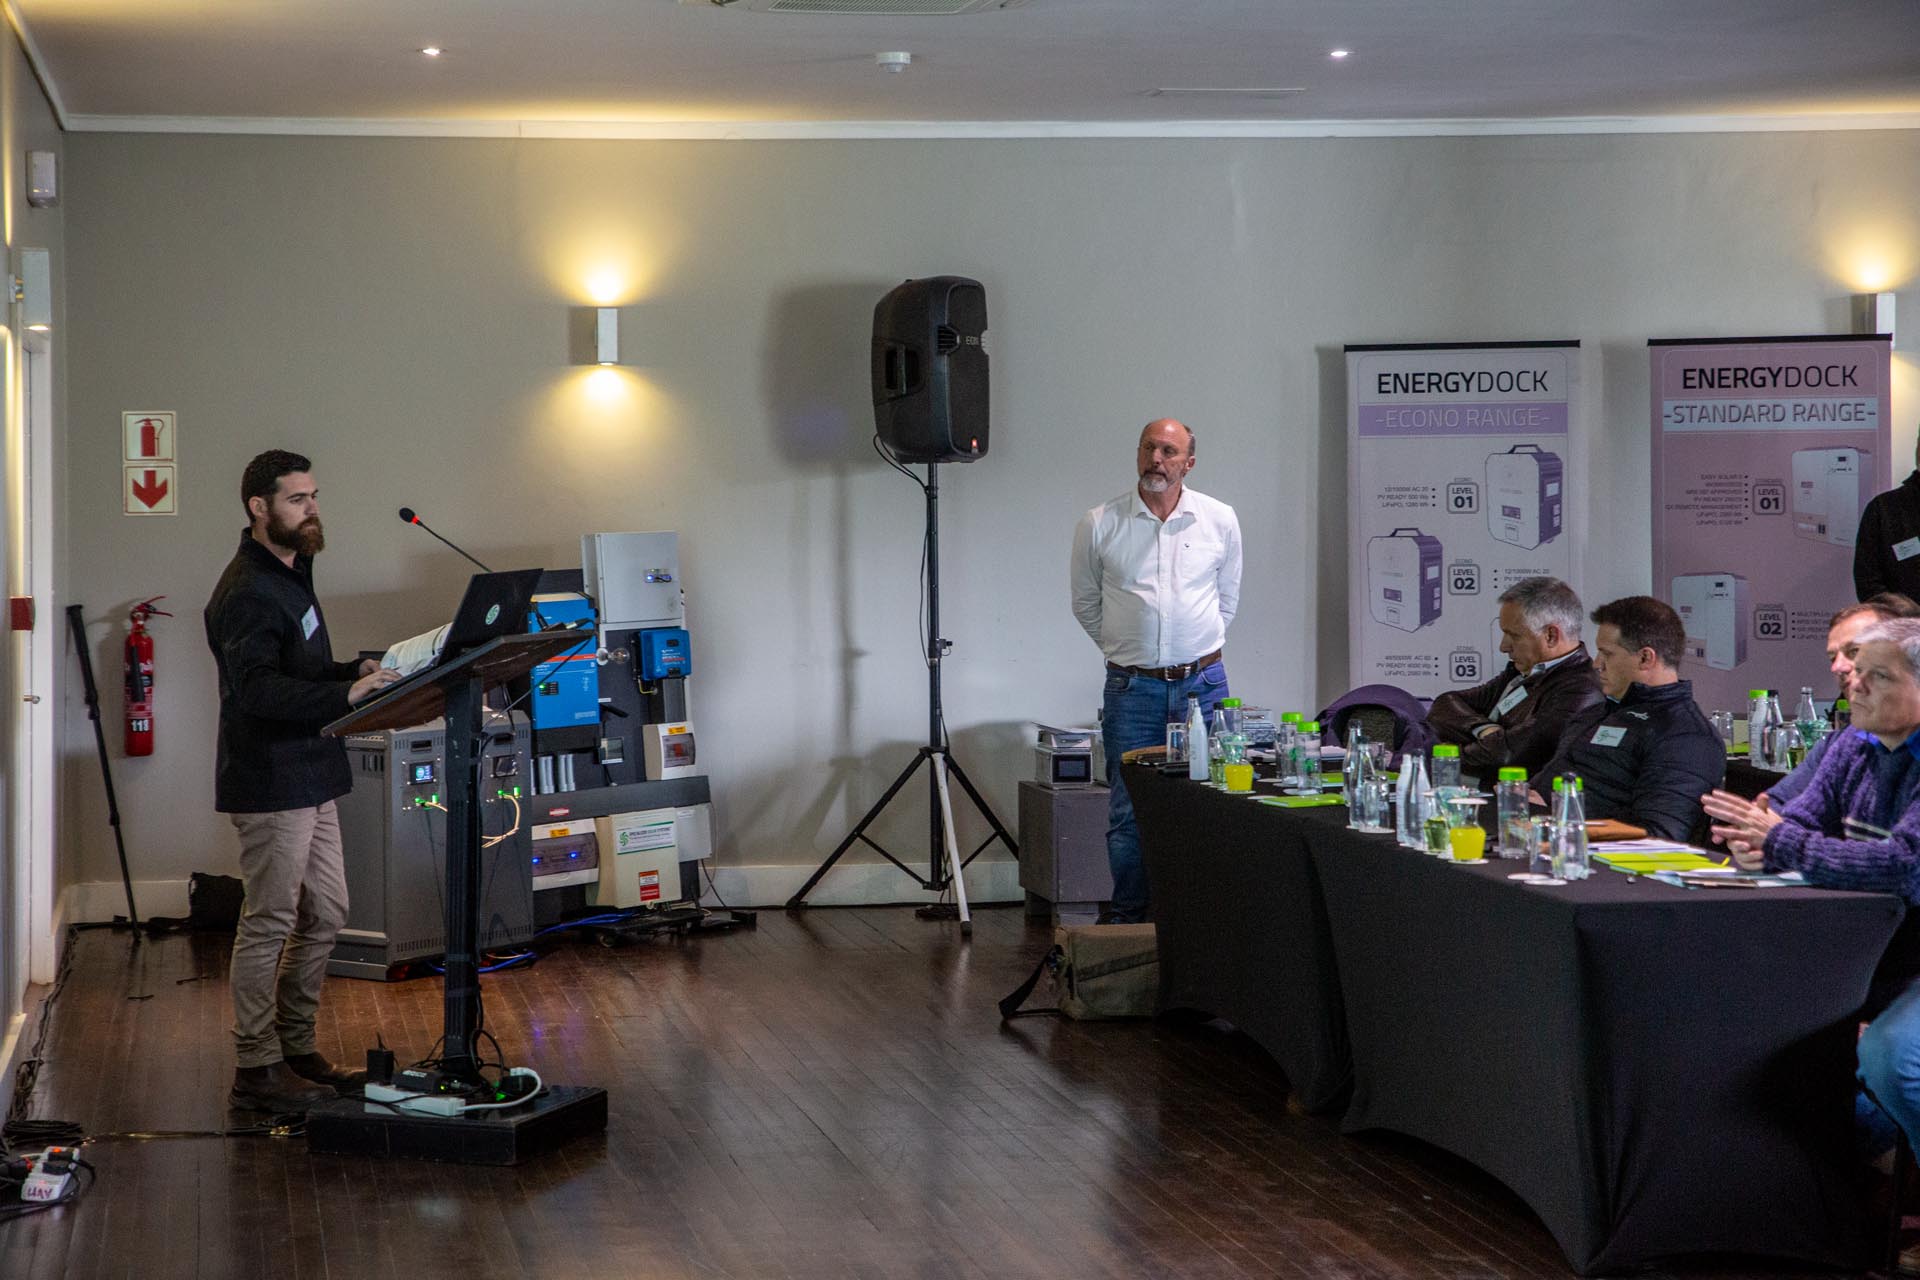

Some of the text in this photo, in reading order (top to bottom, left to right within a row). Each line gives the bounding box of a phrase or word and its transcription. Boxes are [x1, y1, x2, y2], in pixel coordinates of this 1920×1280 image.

[1377, 370, 1548, 394] ENERGYDOCK
[1682, 365, 1858, 389] ENERGYDOCK
[1454, 496, 1472, 508] 01
[1760, 498, 1779, 510] 01
[1454, 578, 1476, 590] 02
[1760, 622, 1782, 635] 02
[1456, 664, 1476, 677] 03
